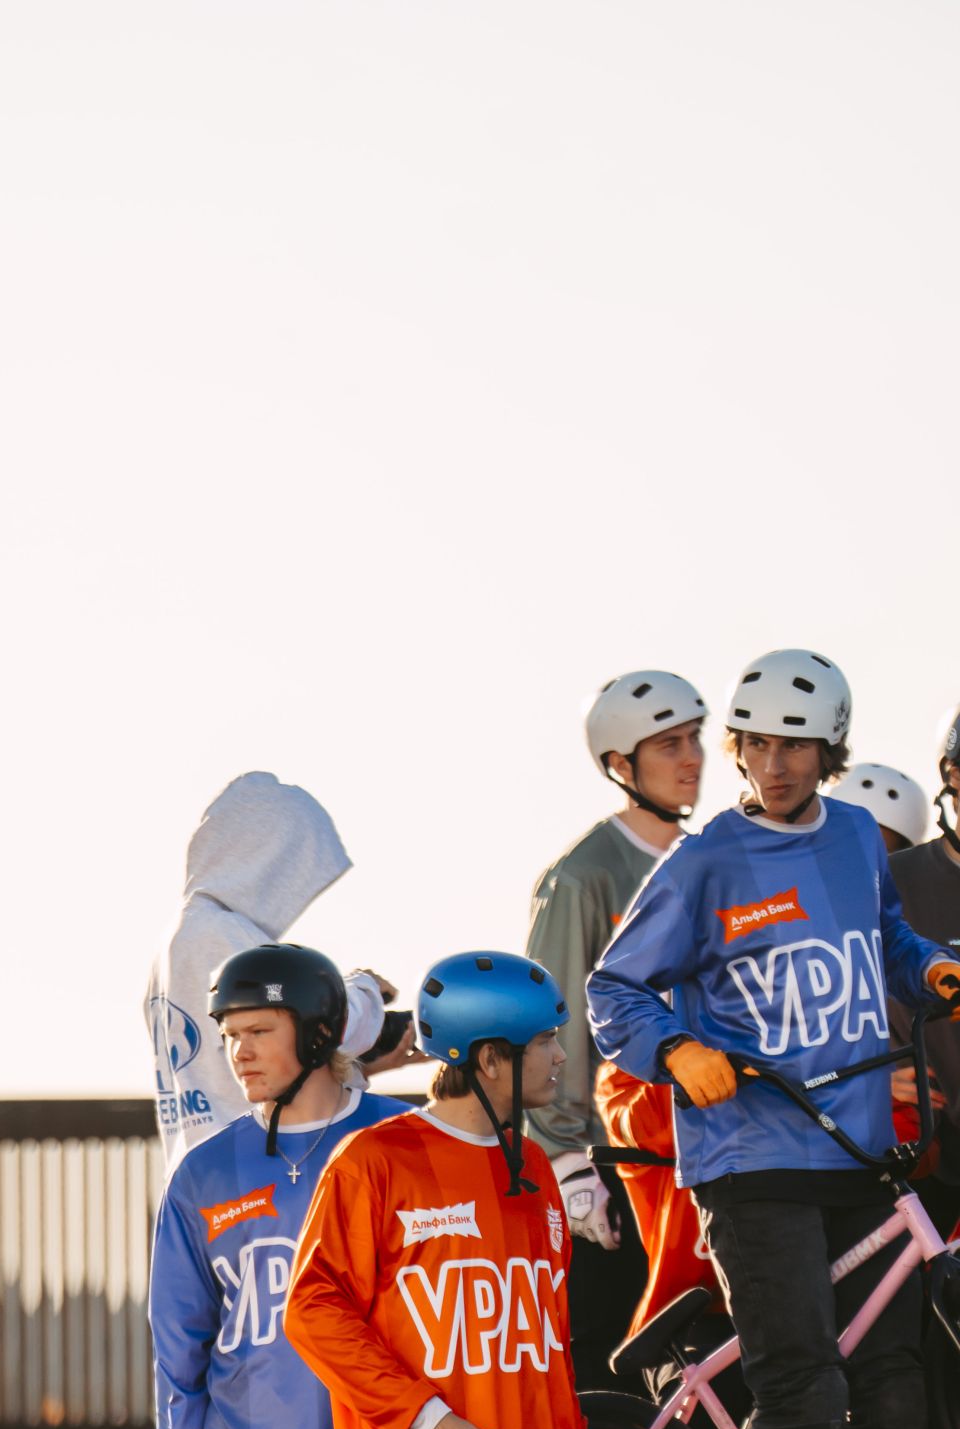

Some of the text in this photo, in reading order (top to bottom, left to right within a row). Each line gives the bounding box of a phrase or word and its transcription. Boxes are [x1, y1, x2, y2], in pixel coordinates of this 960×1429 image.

[731, 901, 796, 931] Альфа Банк
[726, 929, 890, 1056] УРА
[212, 1197, 267, 1230] Альфа Банк
[411, 1214, 472, 1234] Альфа Банк
[212, 1237, 297, 1354] УР
